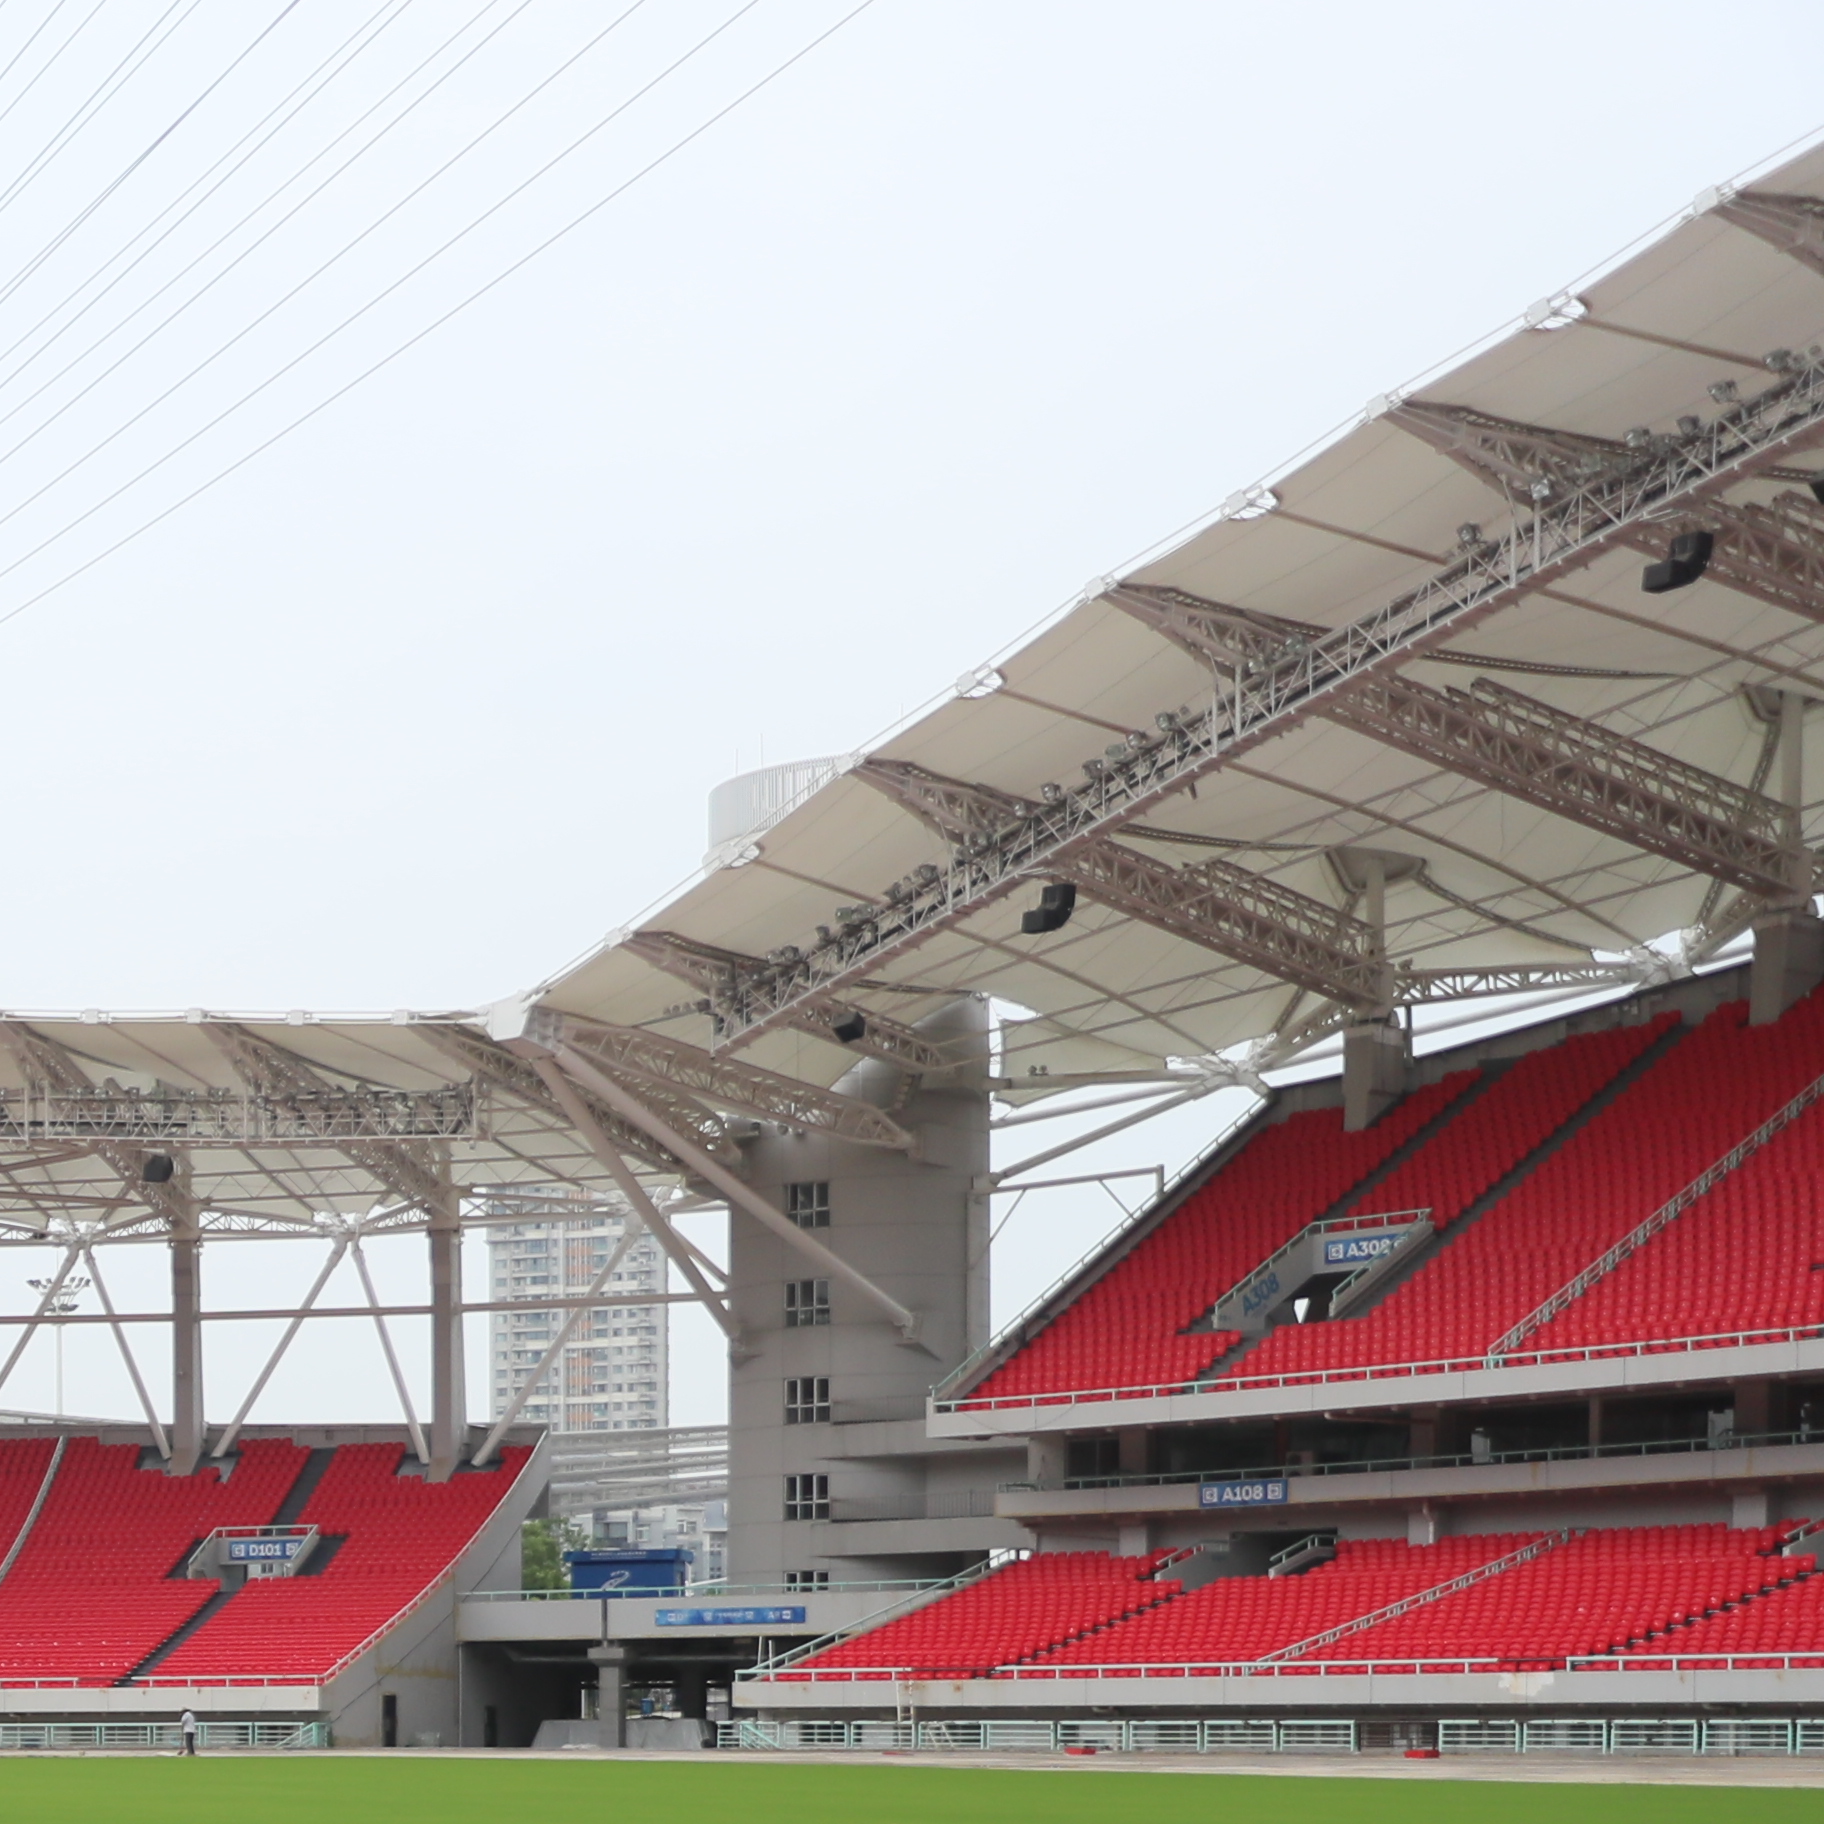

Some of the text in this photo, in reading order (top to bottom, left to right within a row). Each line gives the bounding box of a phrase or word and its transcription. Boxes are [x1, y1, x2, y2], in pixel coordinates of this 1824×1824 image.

[1346, 1238, 1390, 1257] A308
[1242, 1273, 1280, 1316] A308
[1221, 1485, 1263, 1501] A108
[249, 1543, 282, 1556] D101
